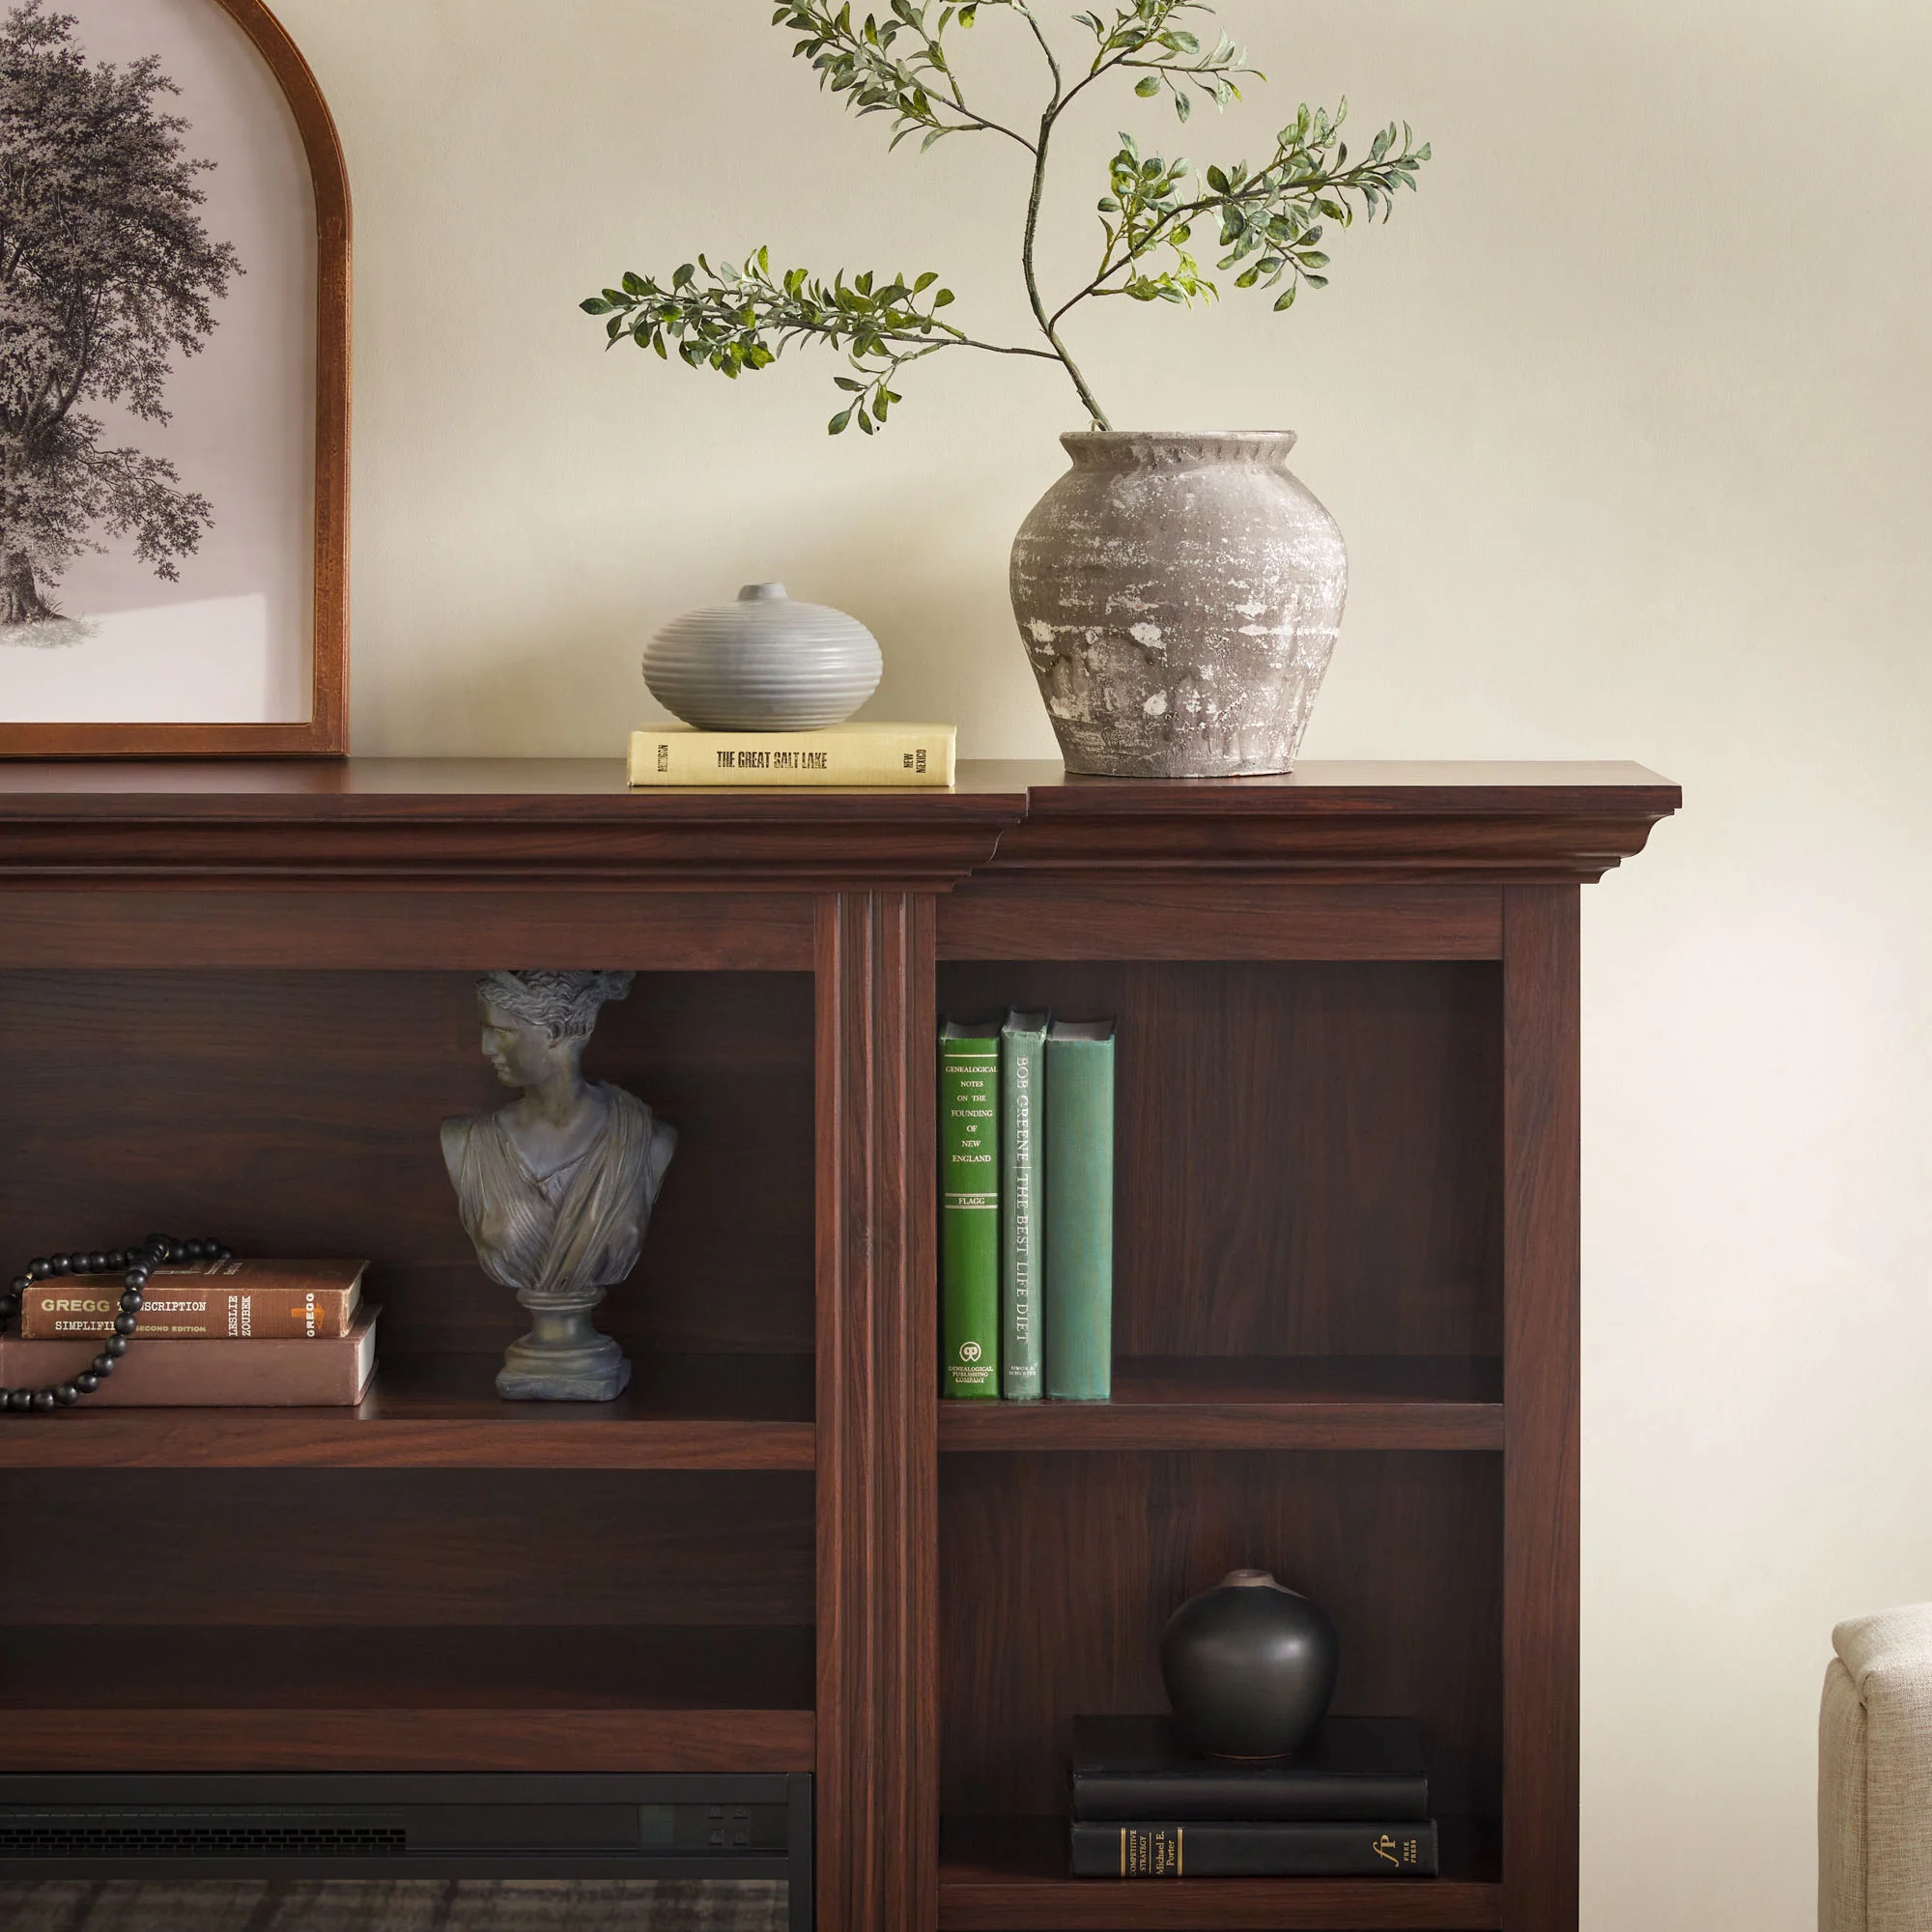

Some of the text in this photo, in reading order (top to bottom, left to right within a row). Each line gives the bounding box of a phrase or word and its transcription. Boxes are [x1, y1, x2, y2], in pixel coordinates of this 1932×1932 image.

[717, 751, 828, 770] THE GREAT SALT LAKE
[903, 753, 914, 768] NEW
[916, 749, 926, 774] MEXICO
[966, 1124, 978, 1133] OF
[958, 1197, 985, 1206] FLAGG
[1016, 1056, 1029, 1344] BOB GREENE THE BEST LIFE DIET
[41, 1298, 110, 1313] GREGG
[228, 1295, 238, 1337] LESLIE
[242, 1295, 251, 1337] ZOUBEK
[305, 1293, 316, 1338] GREGG
[1155, 1831, 1165, 1875] Michael E.
[1166, 1839, 1175, 1866] Porter
